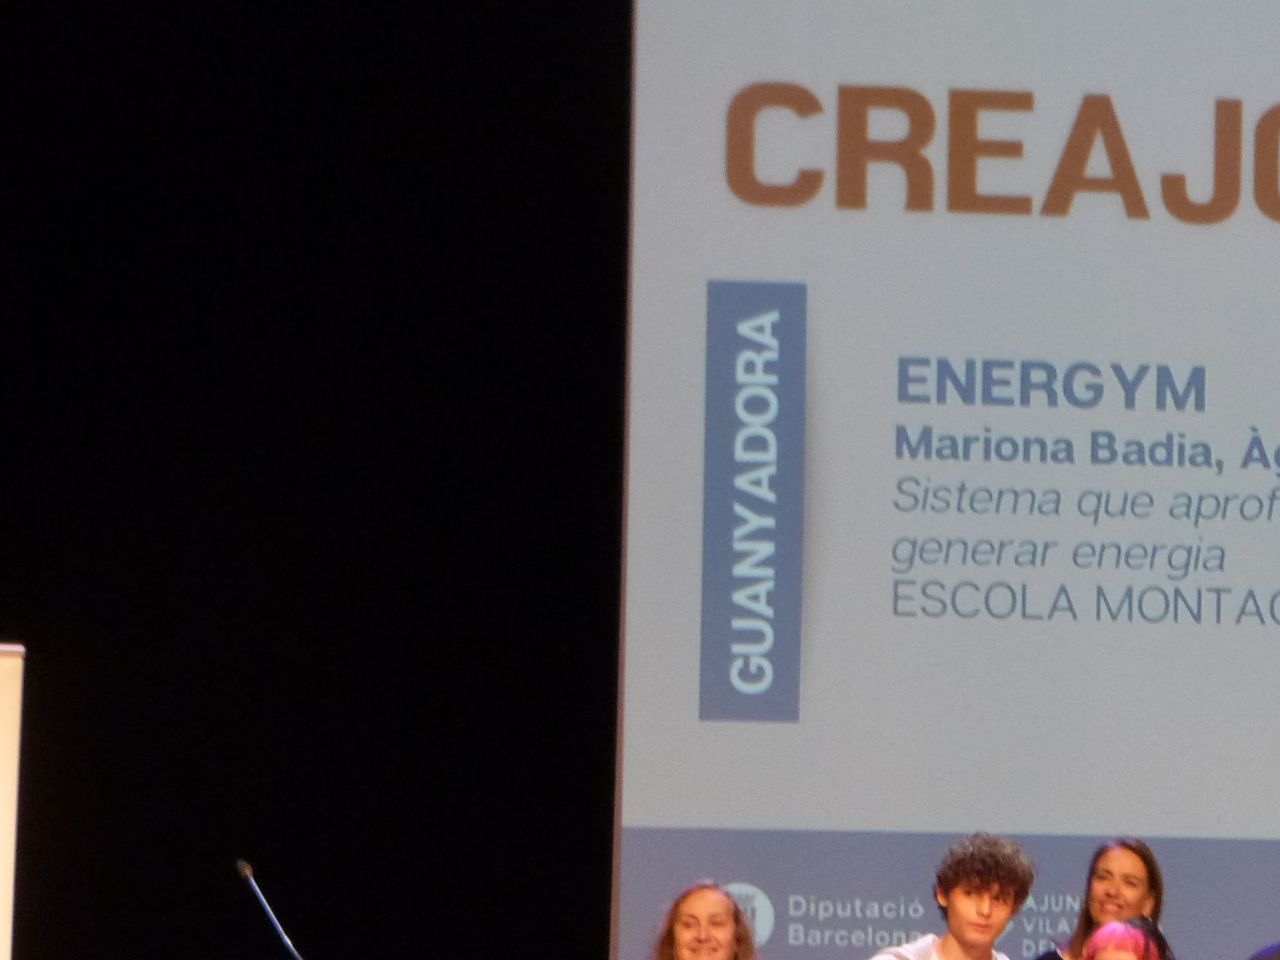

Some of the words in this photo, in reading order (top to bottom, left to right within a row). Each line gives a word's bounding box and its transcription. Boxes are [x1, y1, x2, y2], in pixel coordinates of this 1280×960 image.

[898, 357, 1205, 412] ENERGYM
[895, 425, 1074, 464] Mariona
[1090, 431, 1223, 475] Badia,
[730, 311, 779, 694] GUANYADORA
[893, 476, 1061, 515] Sistema
[1077, 490, 1154, 526] que
[892, 538, 1057, 574] generar
[1072, 537, 1226, 580] energia
[893, 579, 1077, 620] ESCOLA
[788, 894, 925, 921] Diputació
[1022, 894, 1081, 912] AJUN
[1022, 917, 1076, 935] VILA
